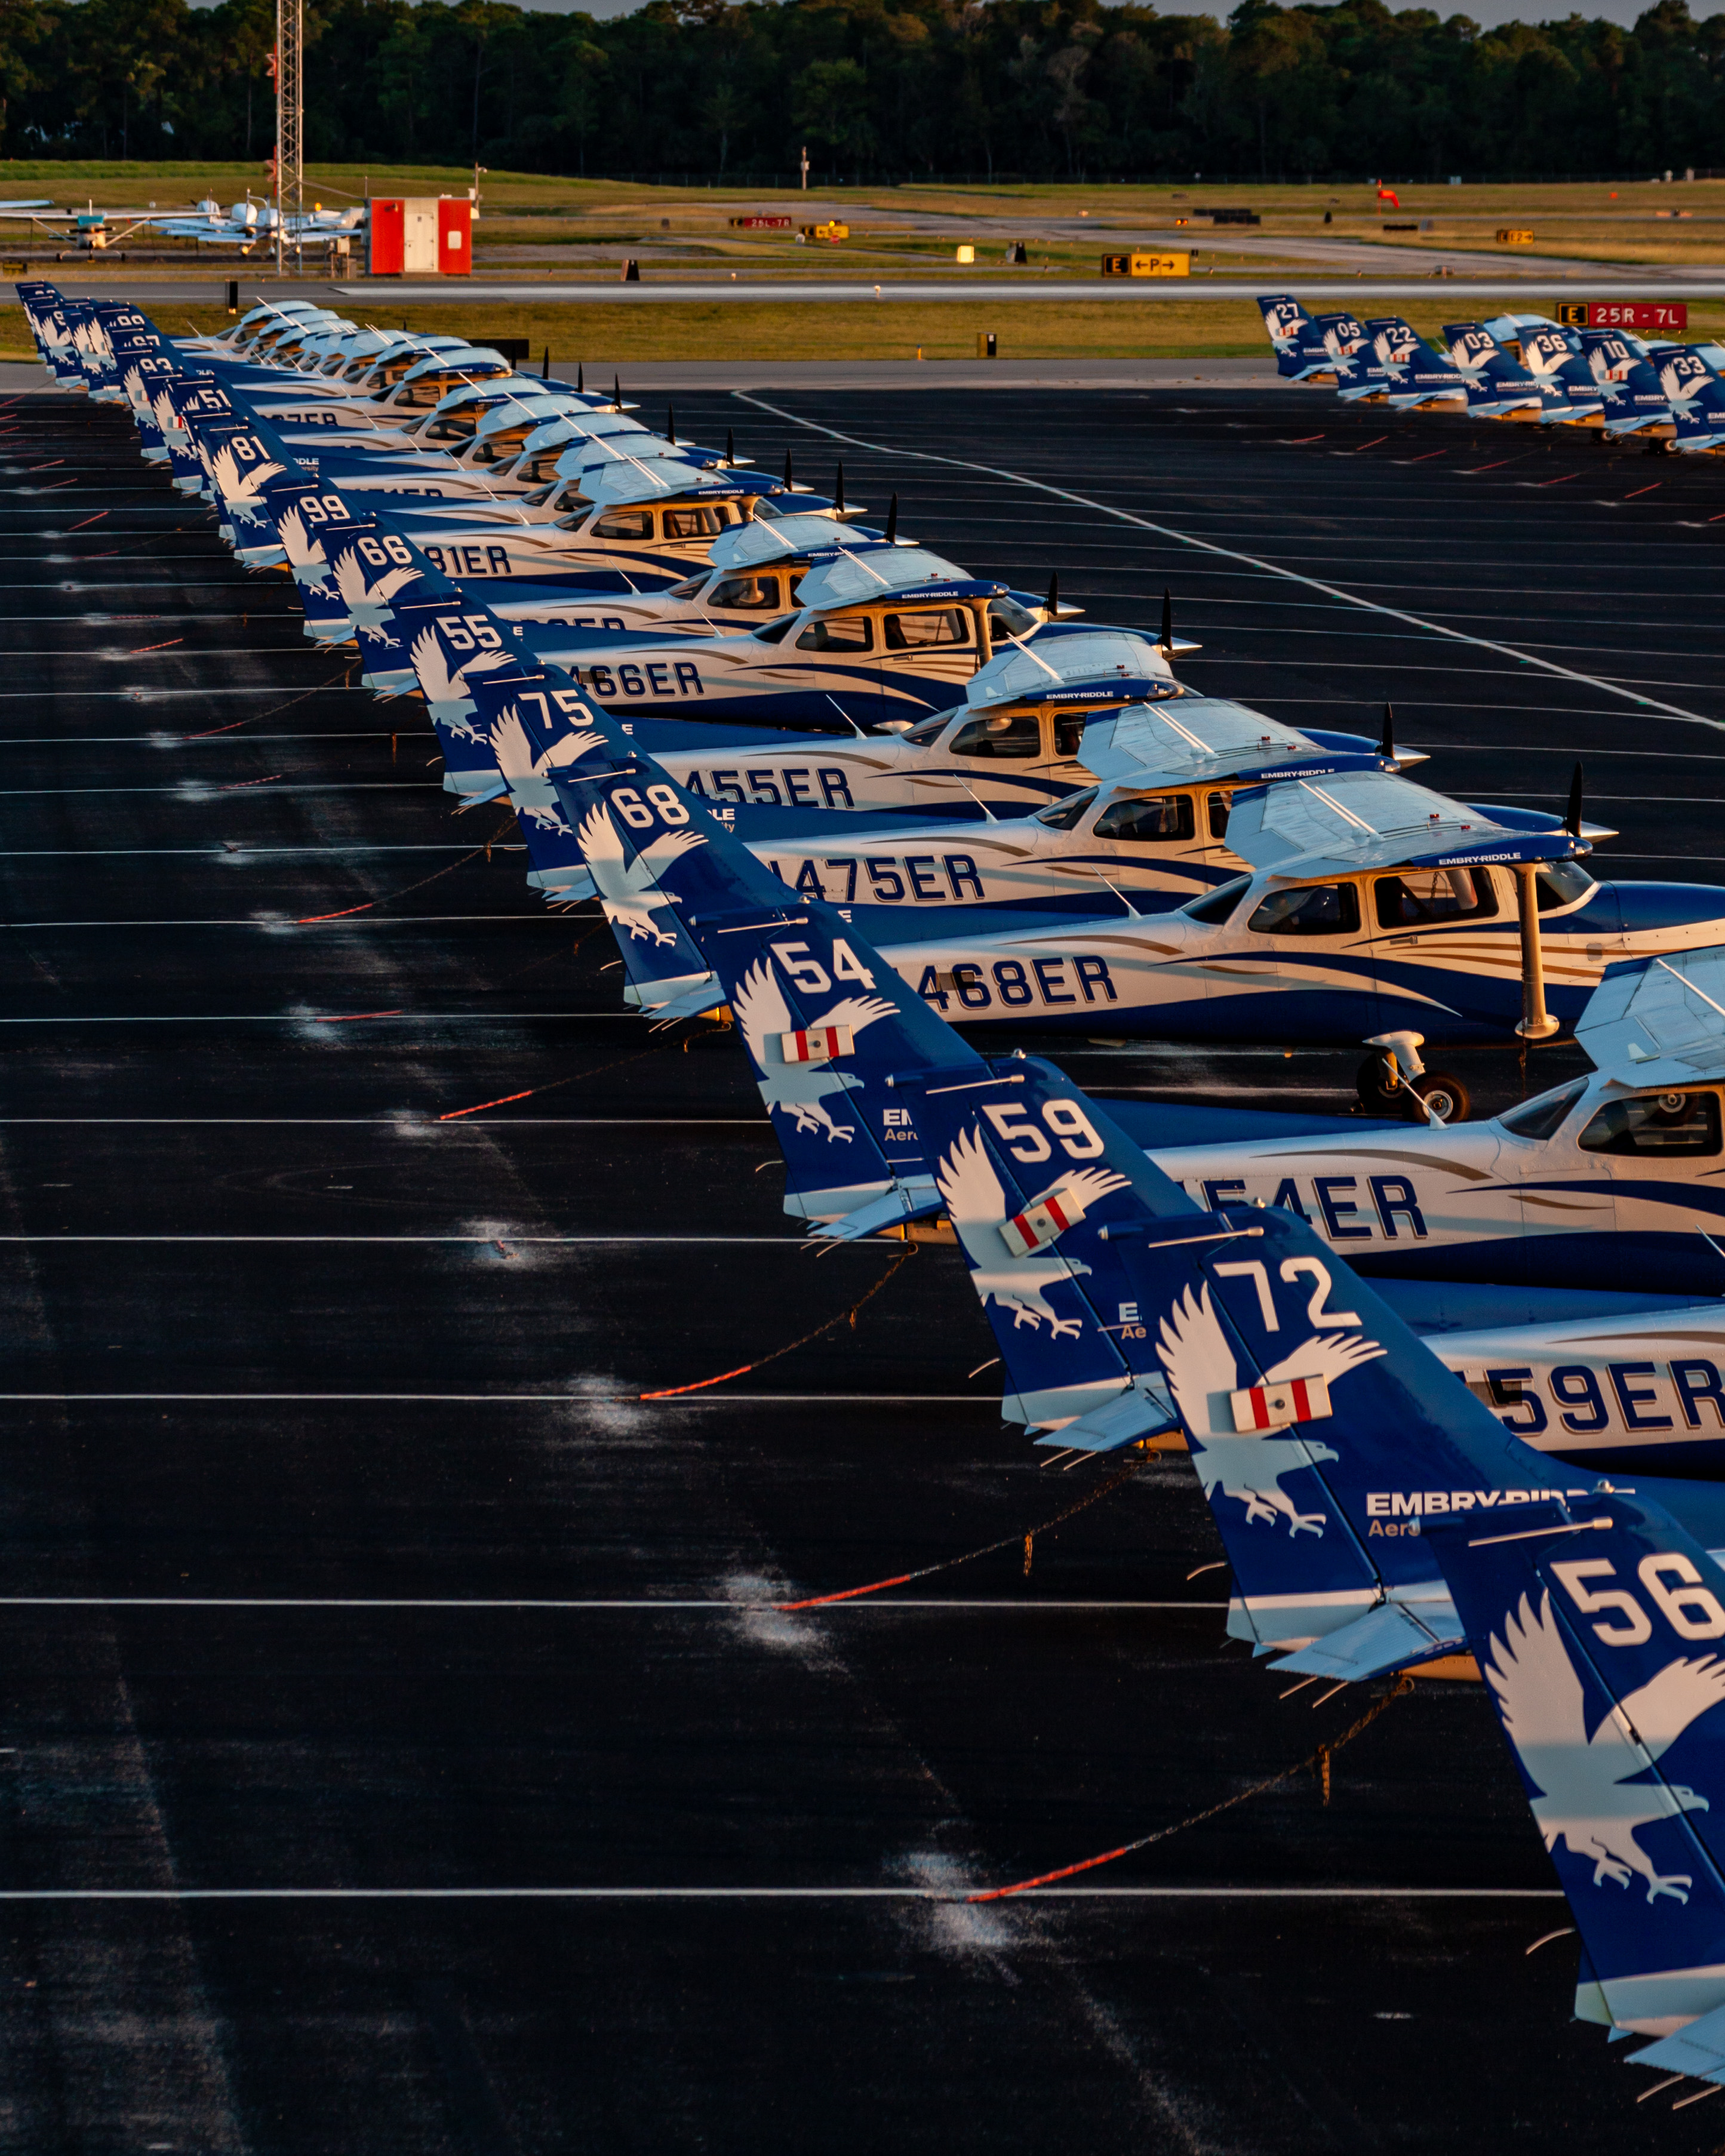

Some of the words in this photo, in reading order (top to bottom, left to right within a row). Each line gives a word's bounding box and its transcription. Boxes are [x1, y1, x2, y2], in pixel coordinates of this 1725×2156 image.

[1112, 257, 1121, 272] E
[1150, 258, 1160, 271] P
[1276, 303, 1300, 319] 27
[1568, 306, 1578, 322] E
[1336, 322, 1361, 337] 05
[1385, 327, 1416, 344] 22
[1464, 332, 1495, 349] 03
[1536, 334, 1568, 352] 36
[1602, 340, 1630, 359] 10
[1672, 356, 1707, 375] 33
[197, 389, 232, 409] 51
[230, 436, 271, 460] 81
[299, 495, 351, 523] 99
[358, 535, 413, 566] 66
[902, 590, 959, 599] EMBRY-RIDDLE
[435, 614, 503, 648] 55
[1046, 691, 1115, 700] EMBRY-RIDDLE
[518, 689, 594, 729] 75
[610, 784, 690, 828] 68
[1438, 852, 1521, 865] EMBRY-RIDDLE
[770, 938, 877, 994] 54
[981, 1099, 1105, 1164] 59
[1213, 1256, 1363, 1333] 72
[1549, 1552, 1725, 1647] 56
